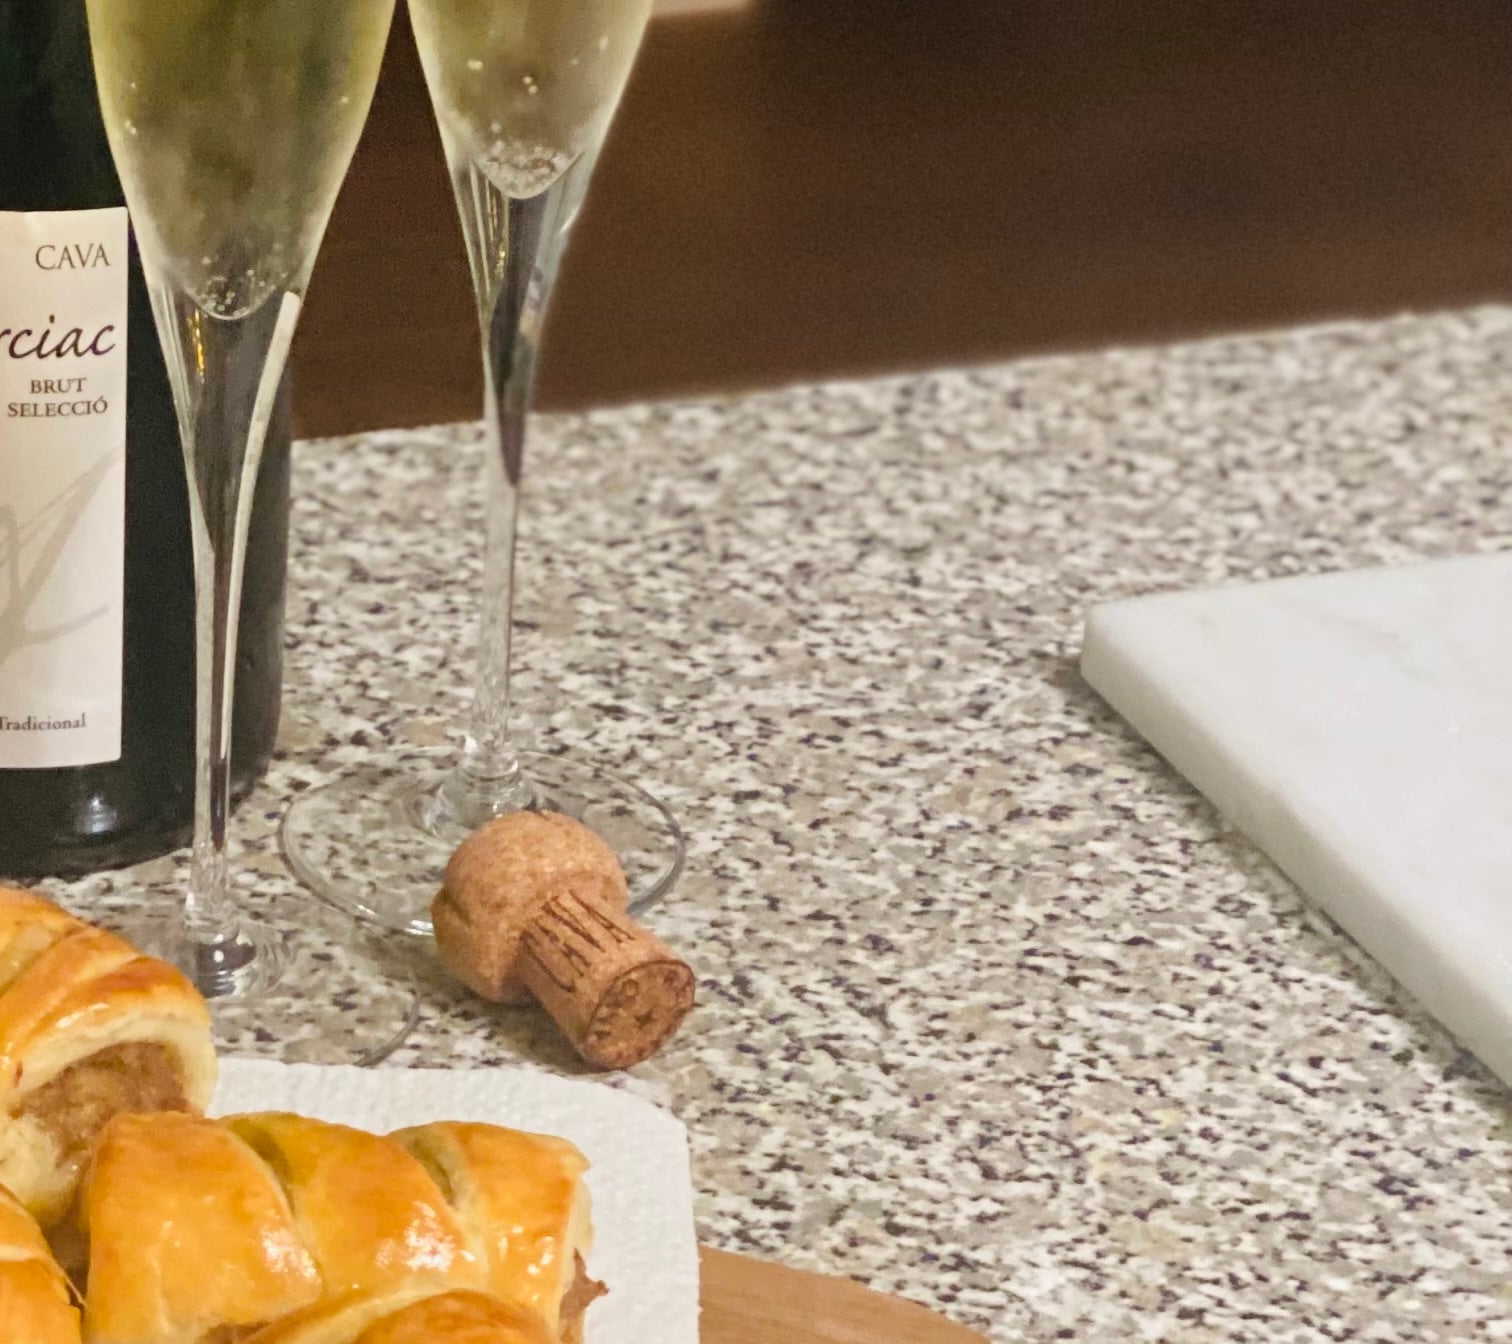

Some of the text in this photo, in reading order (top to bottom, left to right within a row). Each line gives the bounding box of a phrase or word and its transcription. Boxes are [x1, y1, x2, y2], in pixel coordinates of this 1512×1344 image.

[35, 242, 110, 271] CAVA
[29, 377, 87, 395] BRUT
[7, 396, 108, 418] SELECCIÓ
[519, 889, 636, 993] CAVA
